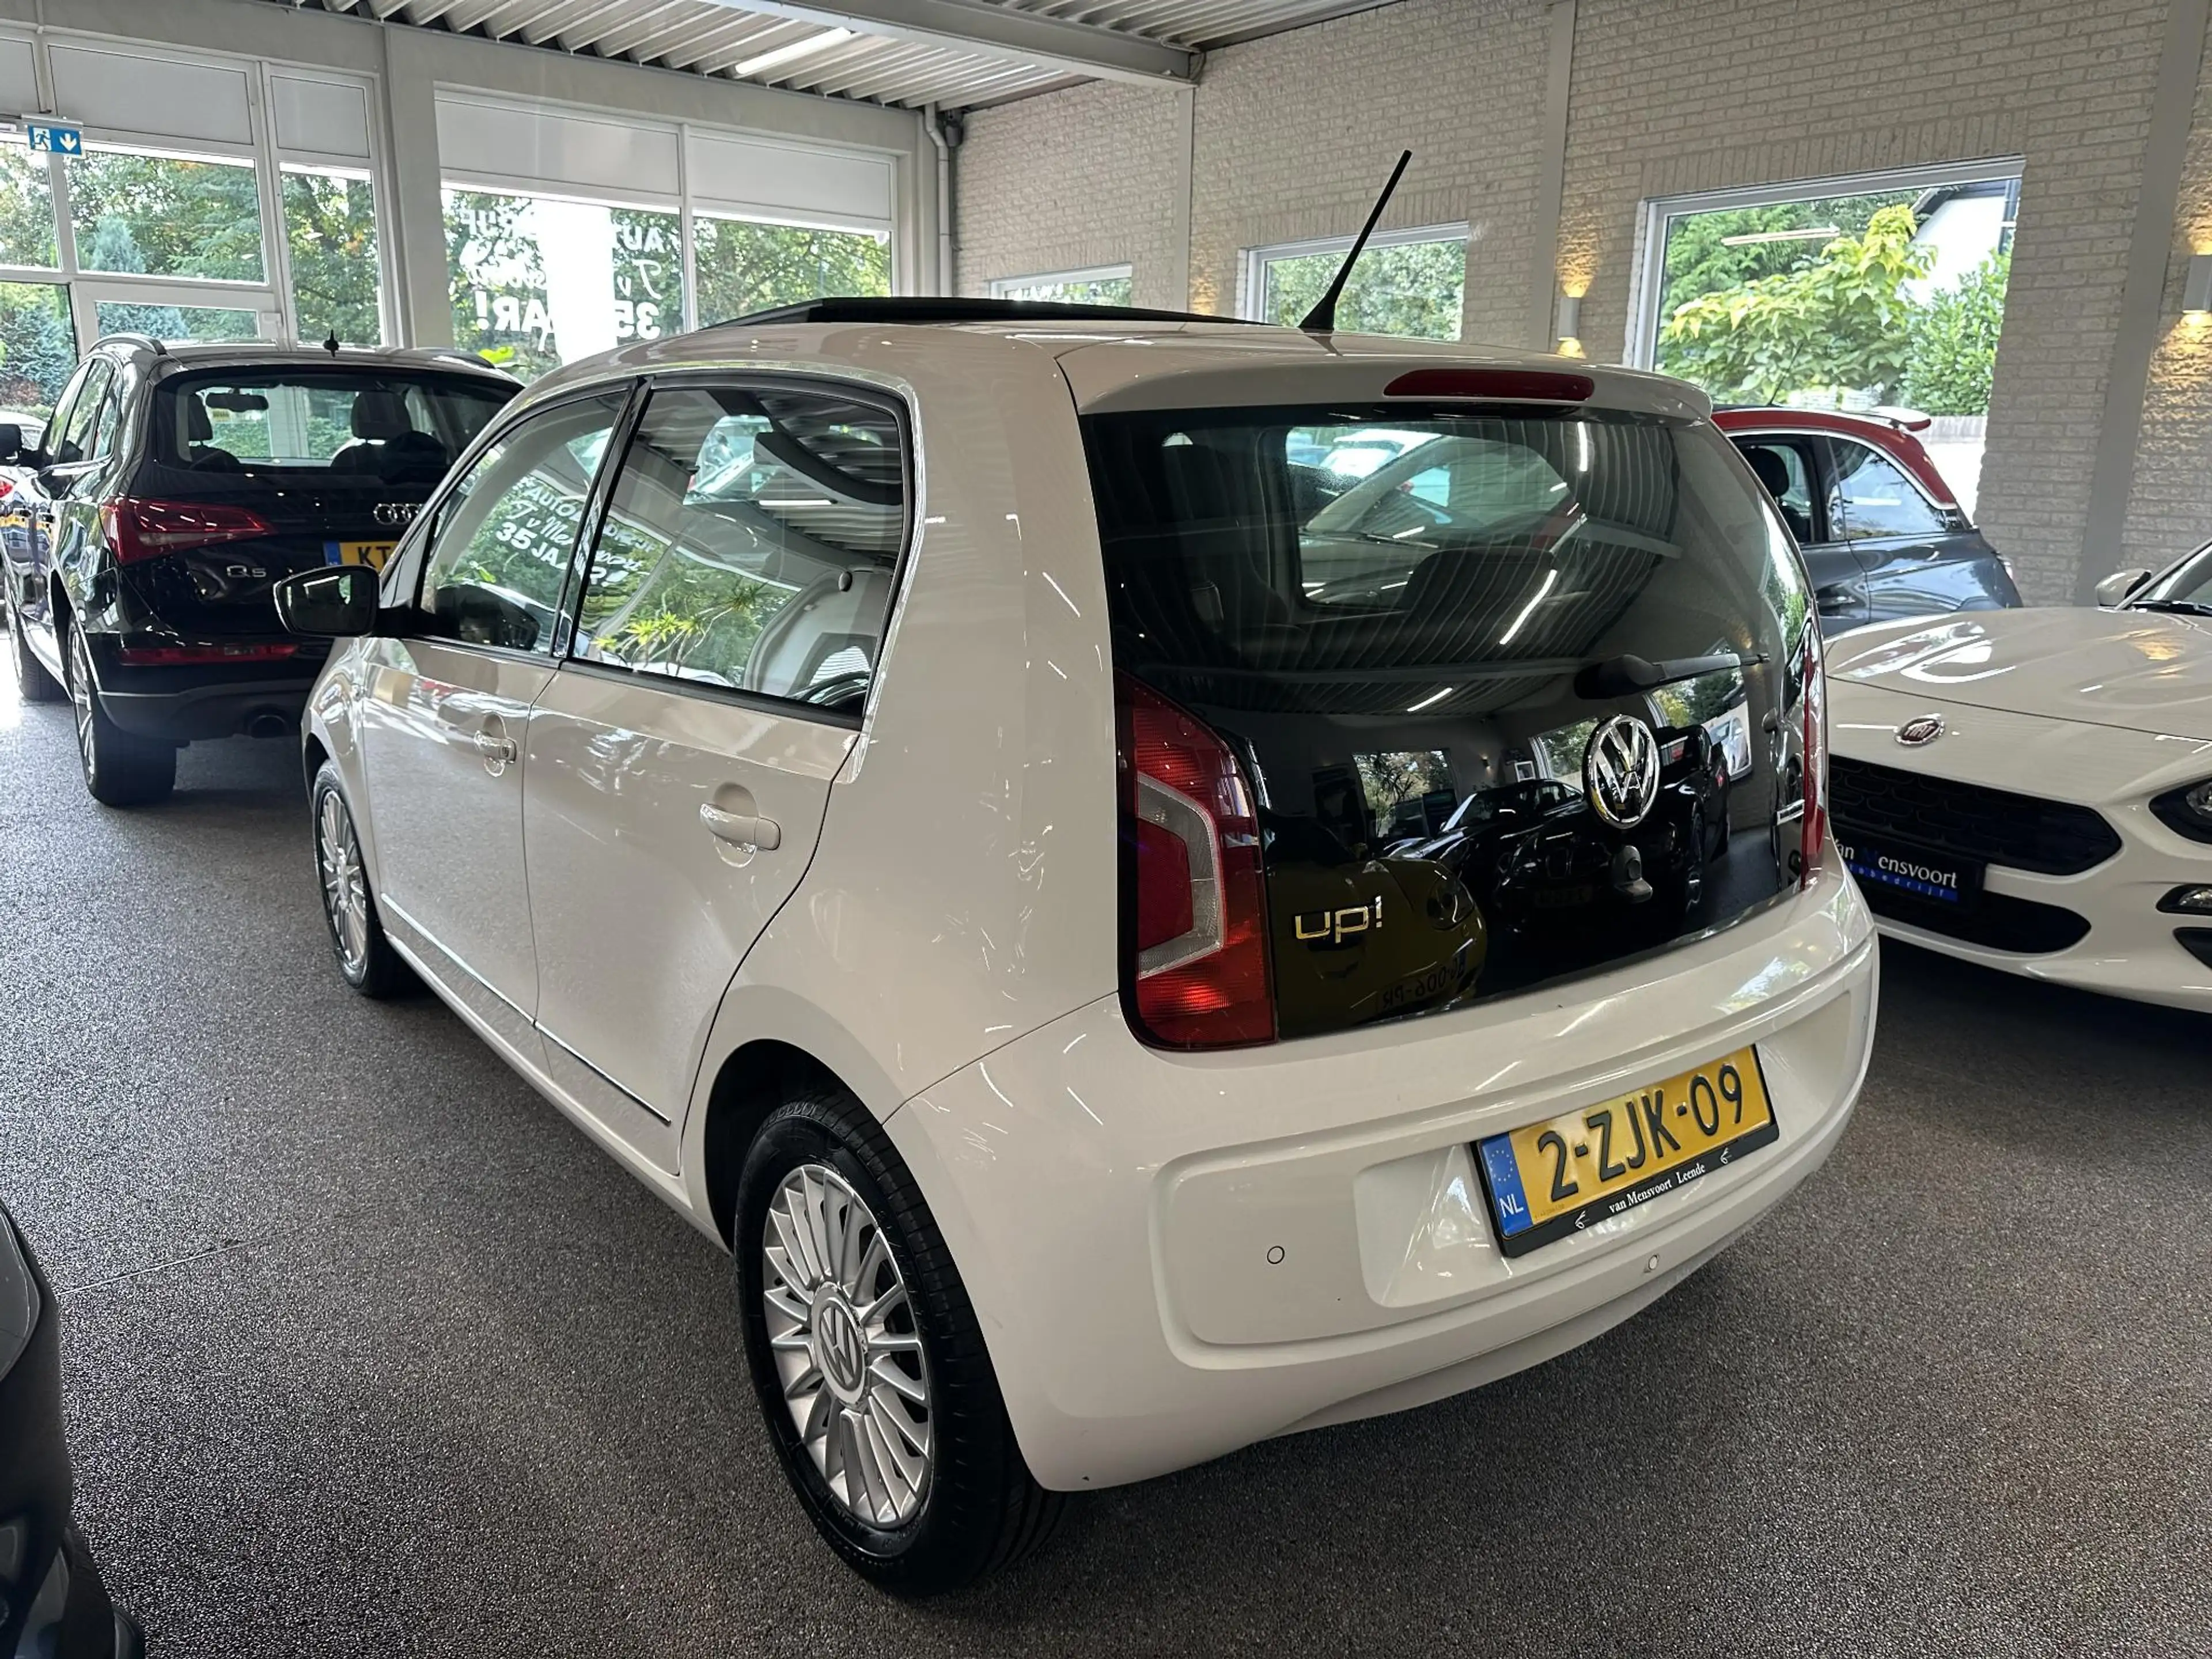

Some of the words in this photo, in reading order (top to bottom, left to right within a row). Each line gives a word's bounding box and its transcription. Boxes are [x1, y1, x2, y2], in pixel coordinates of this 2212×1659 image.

[496, 522, 537, 549] 35
[227, 565, 267, 578] Q5
[1835, 838, 1855, 859] an
[1294, 895, 1383, 944] up!
[1608, 1197, 1627, 1214] van
[1626, 1179, 1673, 1209] Mensvoort
[1676, 1162, 1706, 1184] Leende
[1499, 1192, 1524, 1219] NL
